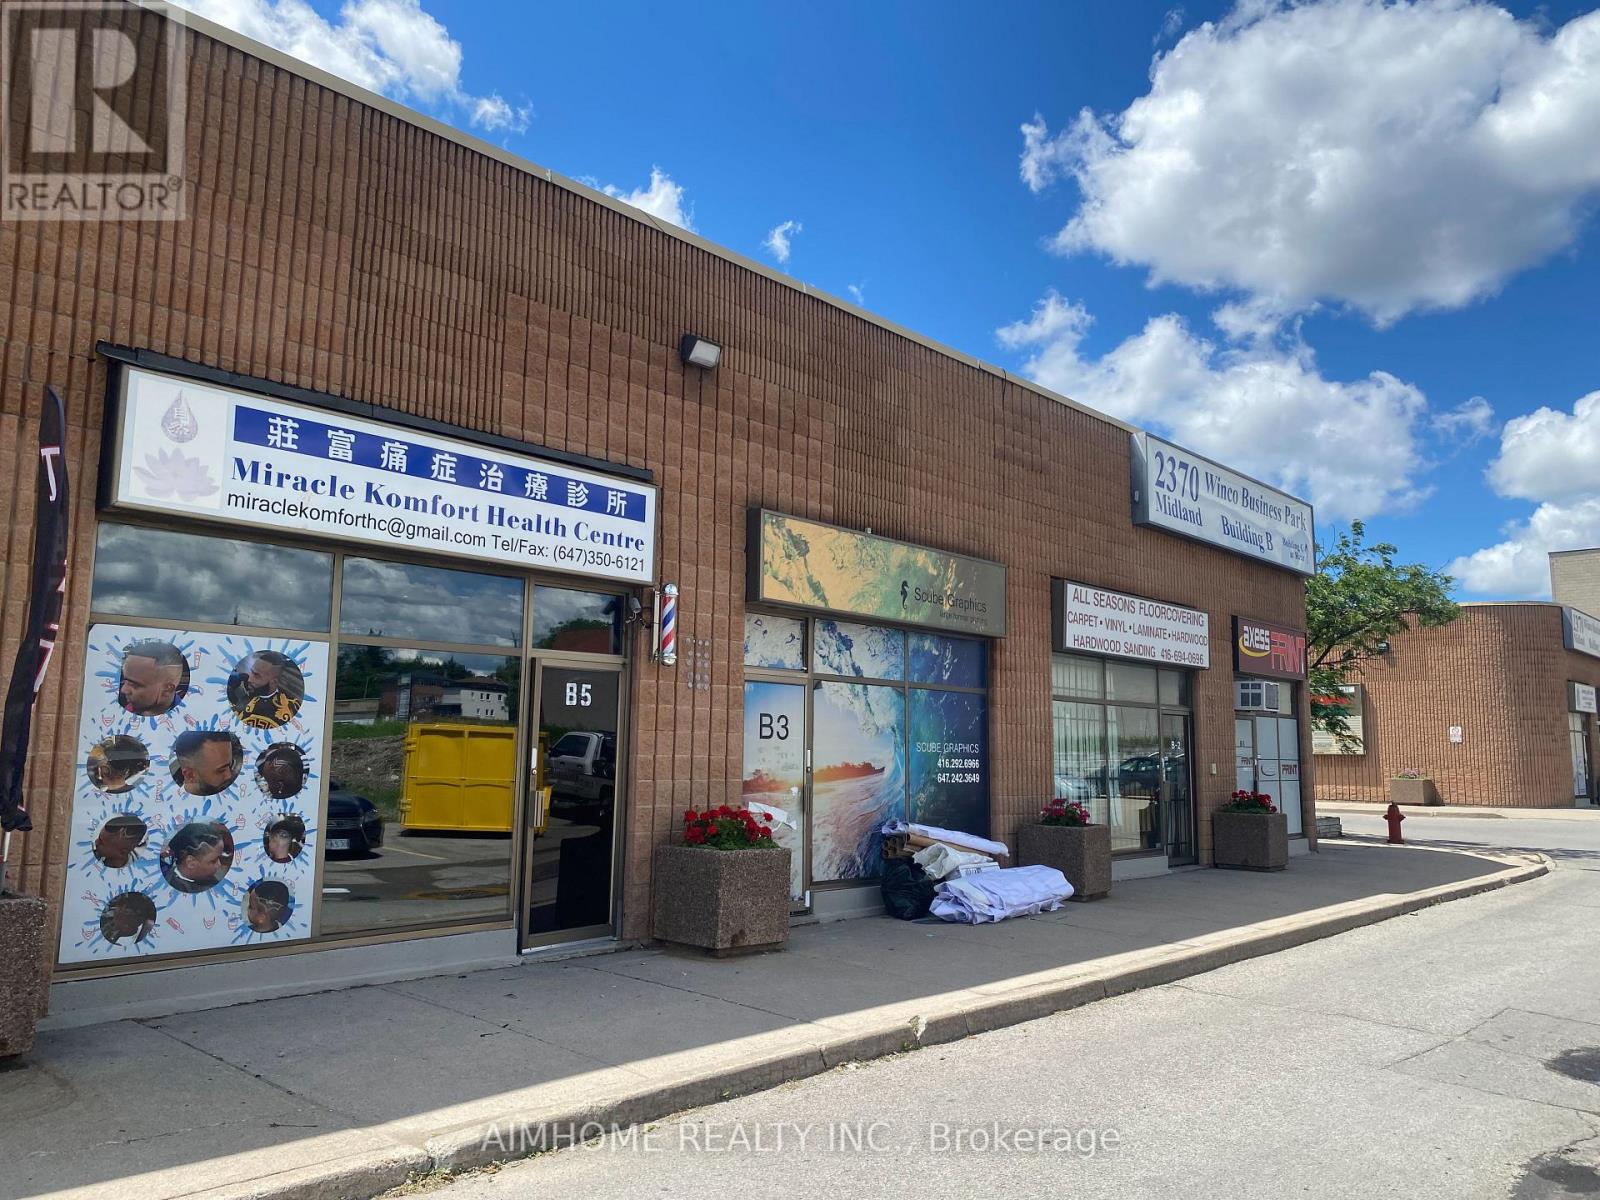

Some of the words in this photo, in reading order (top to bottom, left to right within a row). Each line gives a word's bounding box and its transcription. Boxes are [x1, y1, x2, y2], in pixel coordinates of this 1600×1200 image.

[267, 416, 628, 517] 莊富痛症治療診所
[231, 456, 355, 501] Miracle
[363, 481, 480, 523] Komfort
[487, 505, 567, 538] Health
[573, 521, 645, 552] Centre
[1155, 450, 1200, 502] 2370
[1204, 471, 1239, 505] Winco
[1241, 487, 1282, 522] Business
[1284, 505, 1307, 531] Park
[227, 492, 486, 548] miraclekomforthc@gmail.com
[491, 534, 549, 558] Tel/Fax:
[553, 544, 645, 572] (647)350-6121
[1155, 491, 1203, 527] Midland
[1220, 514, 1266, 554] Building
[1265, 531, 1274, 551] B
[914, 587, 944, 605] Scube
[947, 593, 987, 613] Graphics
[1072, 588, 1091, 605] ALL
[1093, 592, 1136, 614] SEASONS
[1138, 601, 1204, 627] FLOORCOVERING
[1067, 611, 1099, 628] CARPET
[1104, 617, 1128, 633] VINYL
[1132, 623, 1168, 640] LAMINATE
[1171, 631, 1208, 647] HARDWOOD
[1073, 634, 1121, 653] HARDWOOD
[1123, 641, 1156, 658] SANDING
[565, 682, 593, 707] B5
[759, 712, 789, 740] B3
[916, 742, 942, 753] SCUBE
[943, 742, 980, 753] GRAPHICS
[937, 773, 980, 783] 647.242.3649
